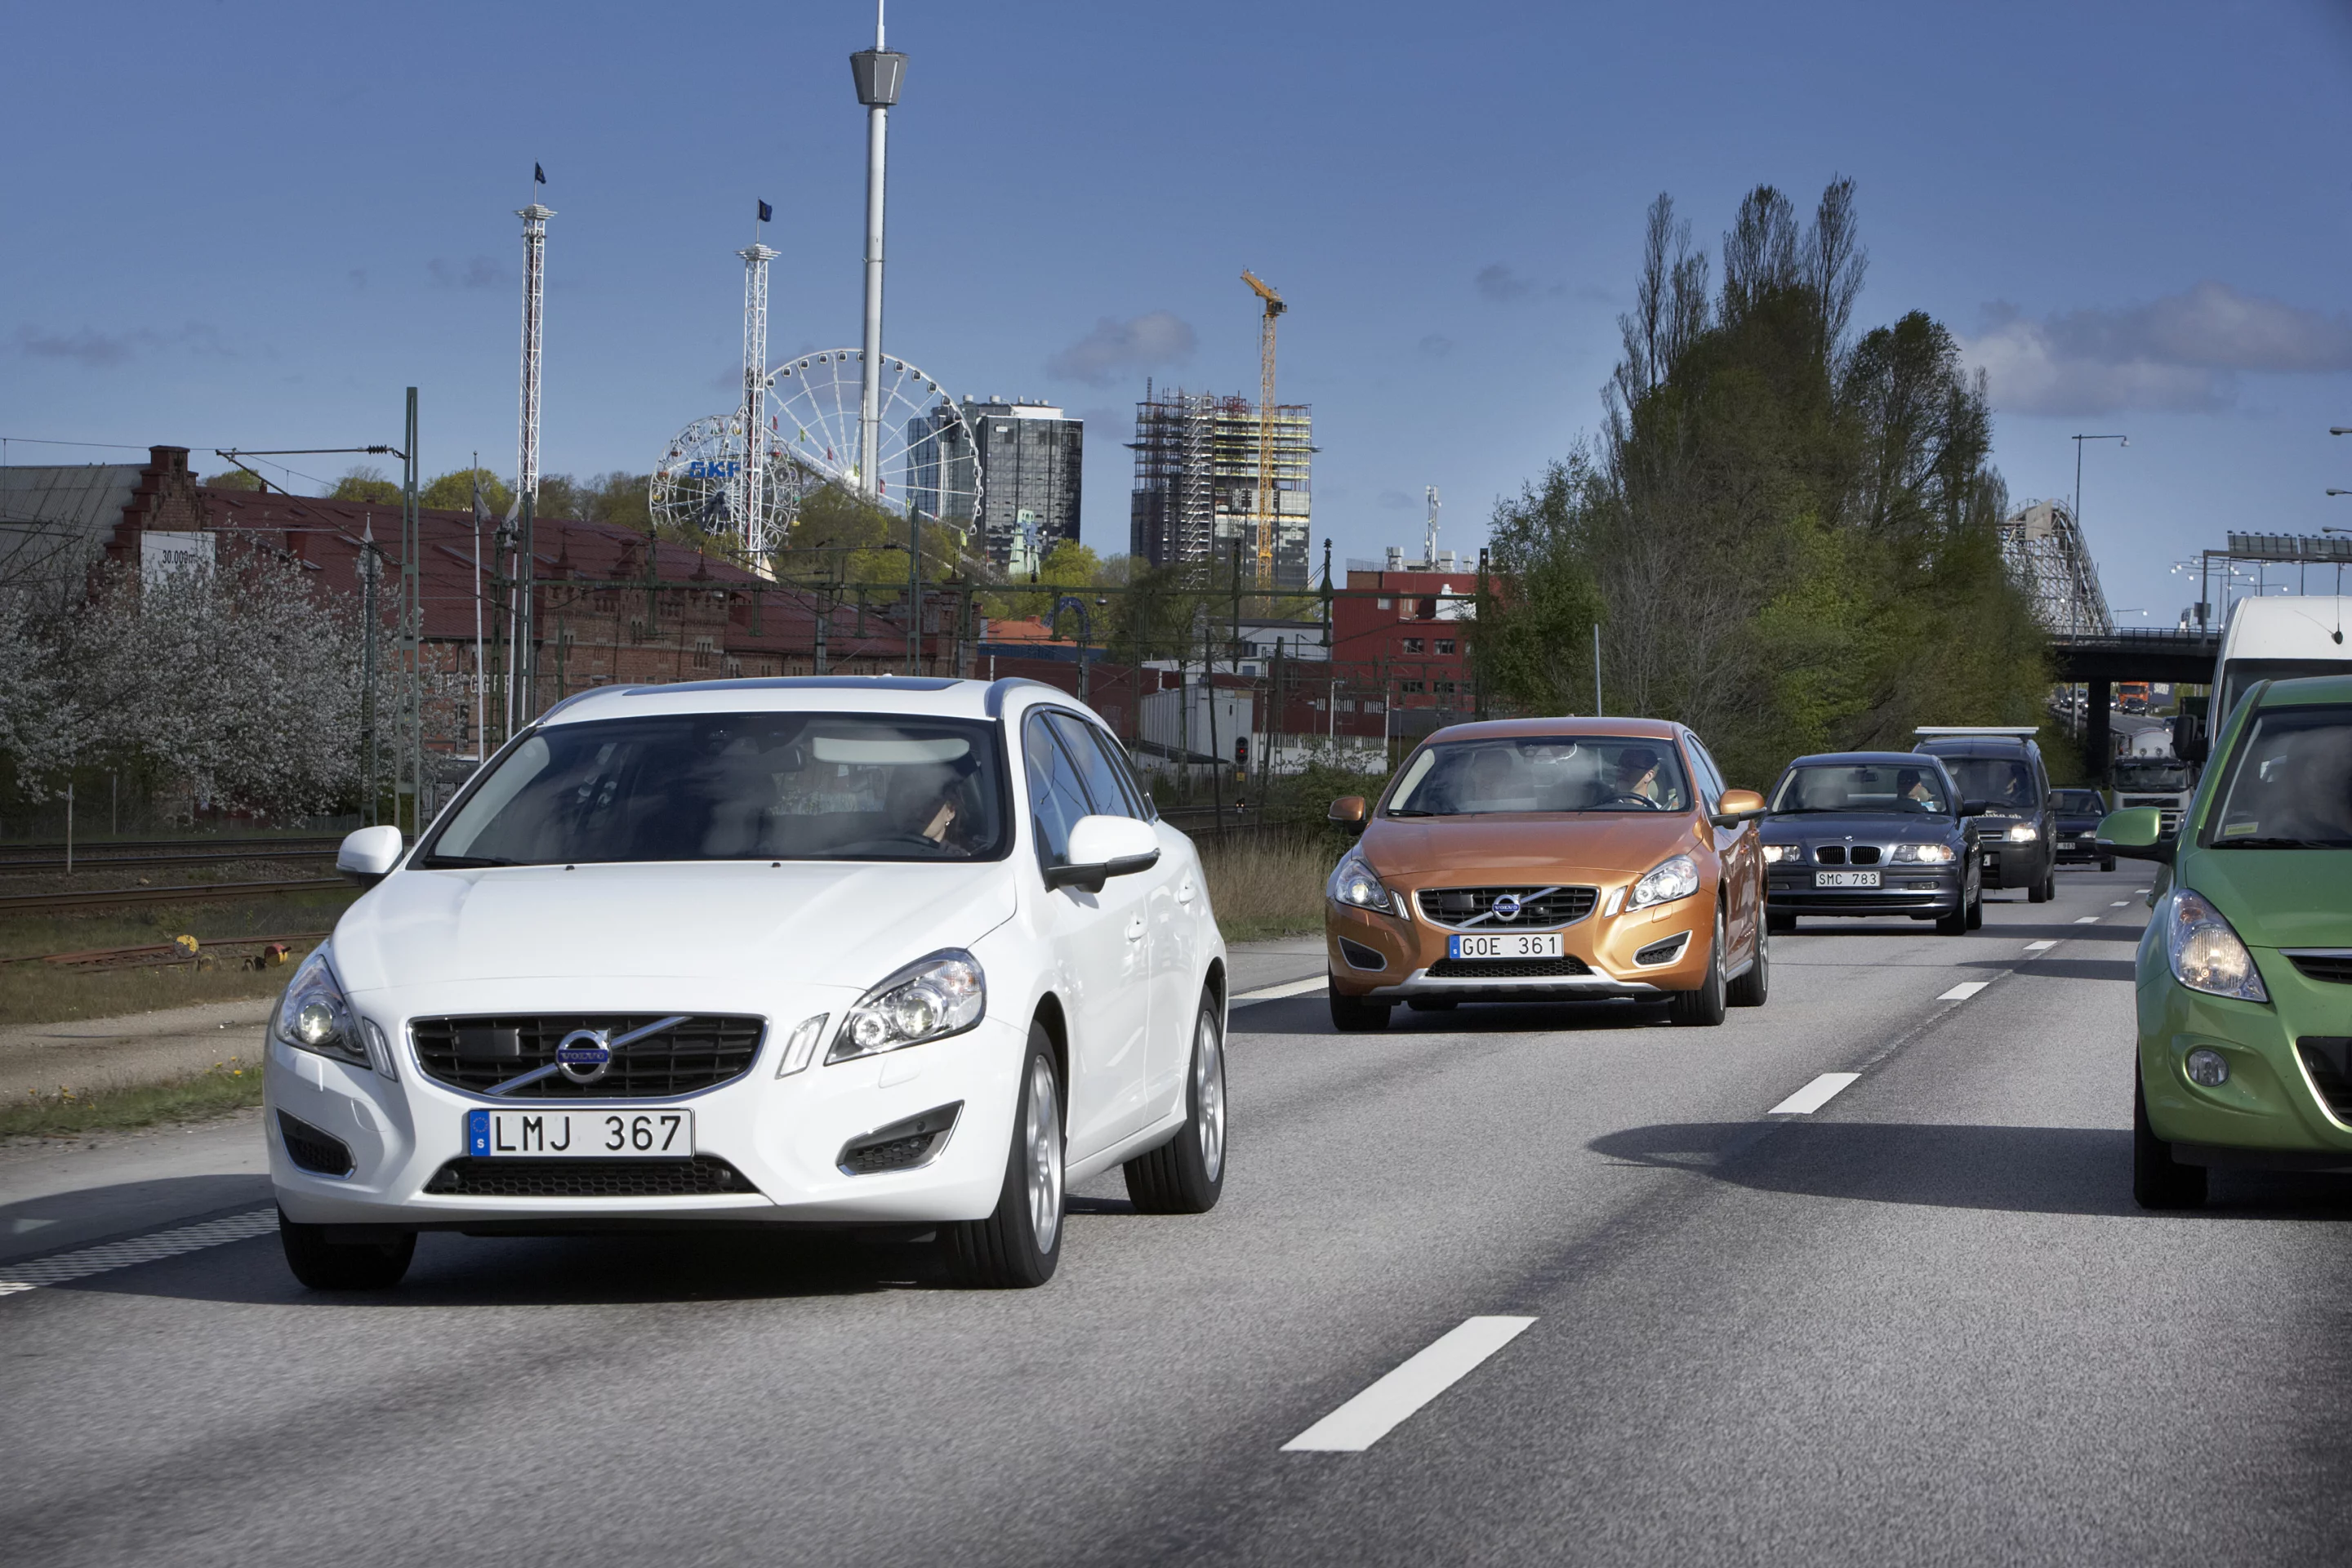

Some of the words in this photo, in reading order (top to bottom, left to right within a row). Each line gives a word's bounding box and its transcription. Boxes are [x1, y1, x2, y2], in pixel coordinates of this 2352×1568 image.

[689, 461, 741, 478] SKF
[1819, 873, 1842, 885] SMC
[1852, 873, 1877, 885] 783
[1463, 938, 1501, 956] GOE
[1518, 937, 1556, 955] 361
[559, 1052, 606, 1060] VOLVO
[496, 1116, 571, 1152] LMJ
[605, 1116, 682, 1152] 367
